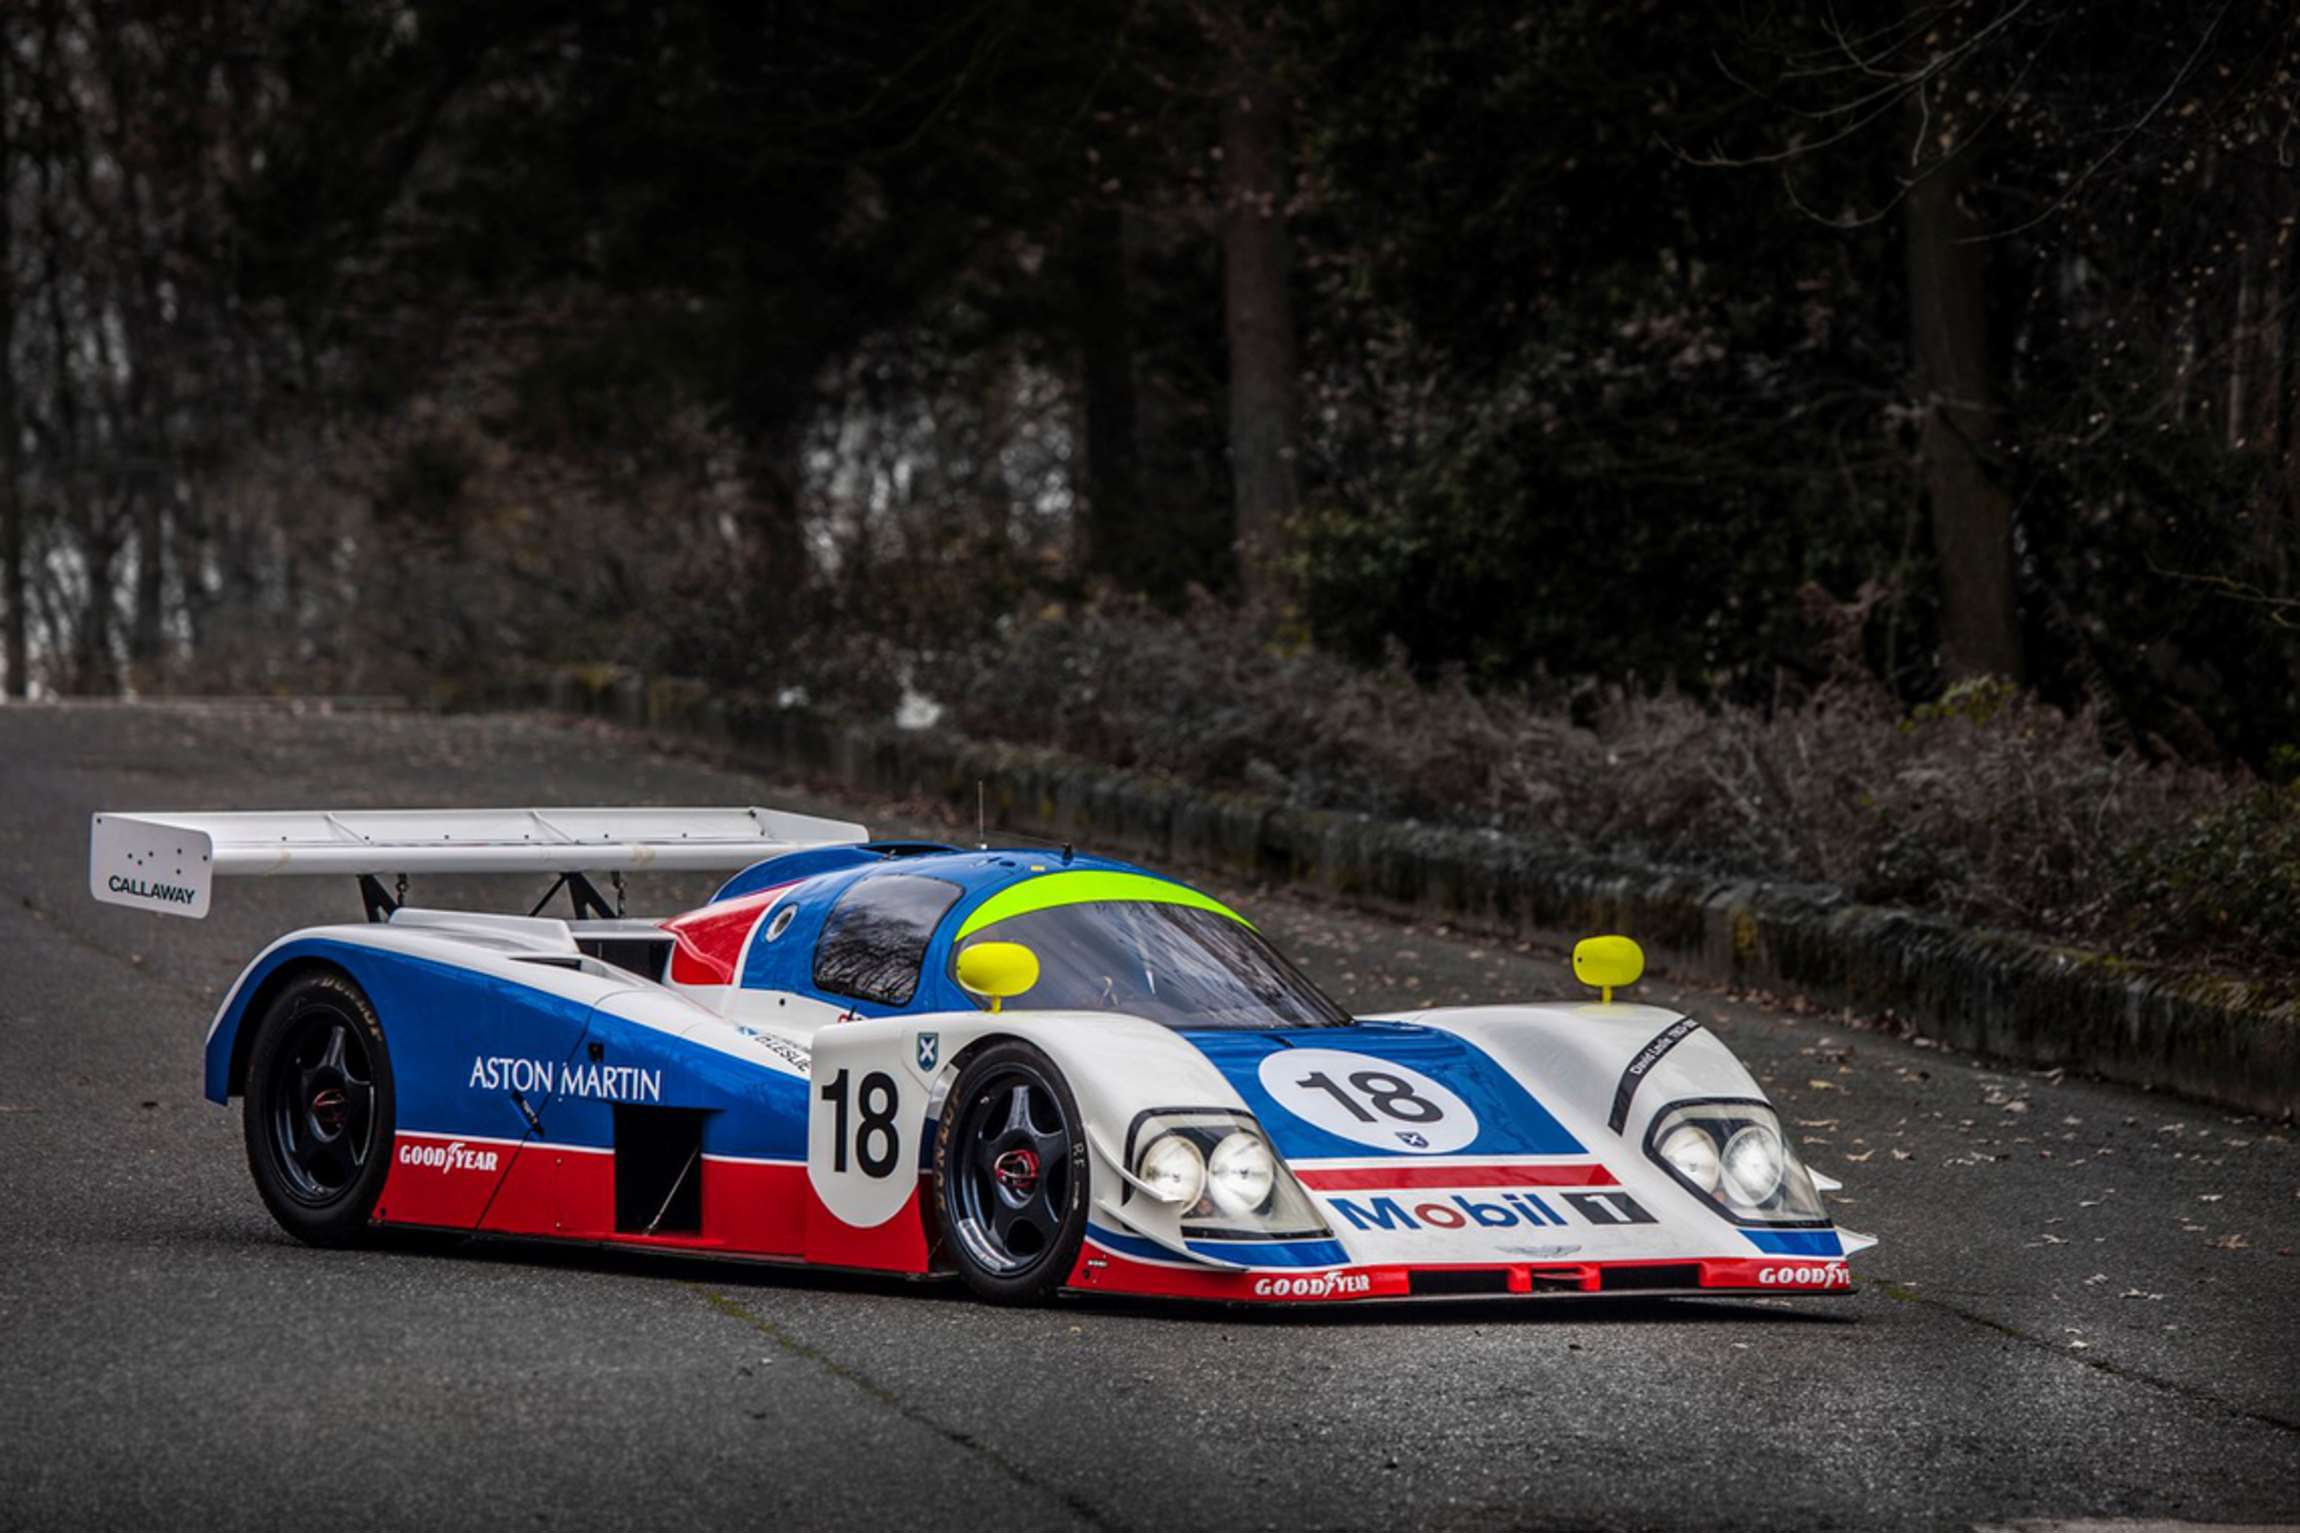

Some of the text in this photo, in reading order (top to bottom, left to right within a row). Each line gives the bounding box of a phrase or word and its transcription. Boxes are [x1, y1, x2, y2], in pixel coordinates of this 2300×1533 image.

[108, 875, 195, 904] CALLAWAY
[469, 1056, 661, 1102] ASTON MARTIN
[1296, 1071, 1444, 1123] 18
[821, 1068, 899, 1179] 18
[399, 1141, 499, 1175] GOODYEAR
[1326, 1193, 1633, 1231] Mobil 1
[1254, 1270, 1371, 1298] GOODYEAR
